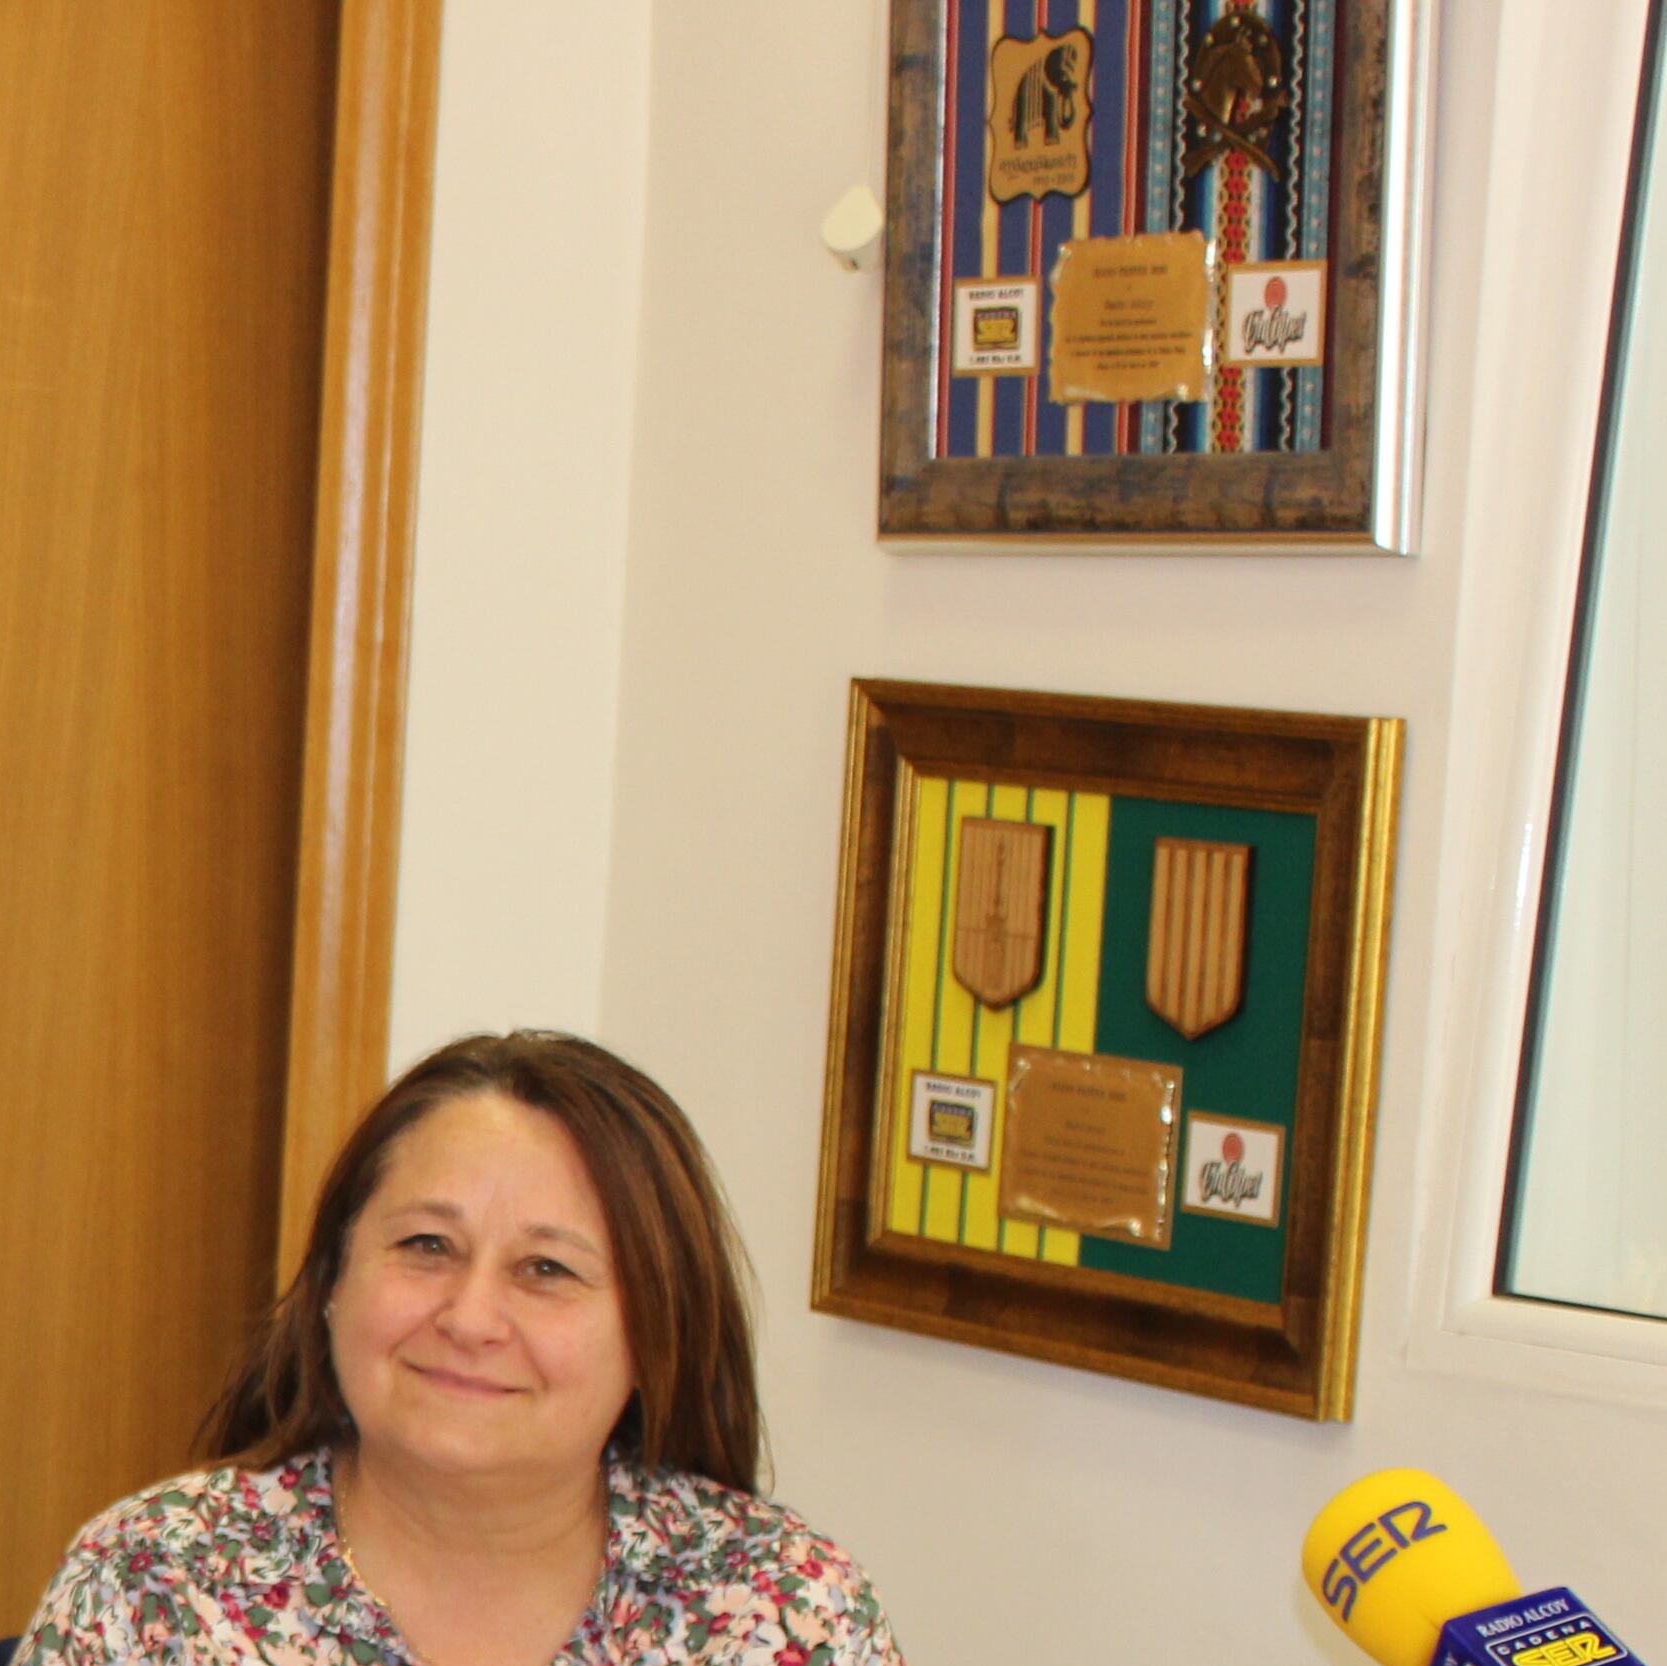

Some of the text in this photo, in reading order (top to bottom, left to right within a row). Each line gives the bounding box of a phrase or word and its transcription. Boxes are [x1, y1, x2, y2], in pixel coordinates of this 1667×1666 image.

[1322, 1501, 1447, 1623] SER
[1476, 1598, 1569, 1638] RADIO ALCOY
[1497, 1619, 1593, 1656] CADENA
